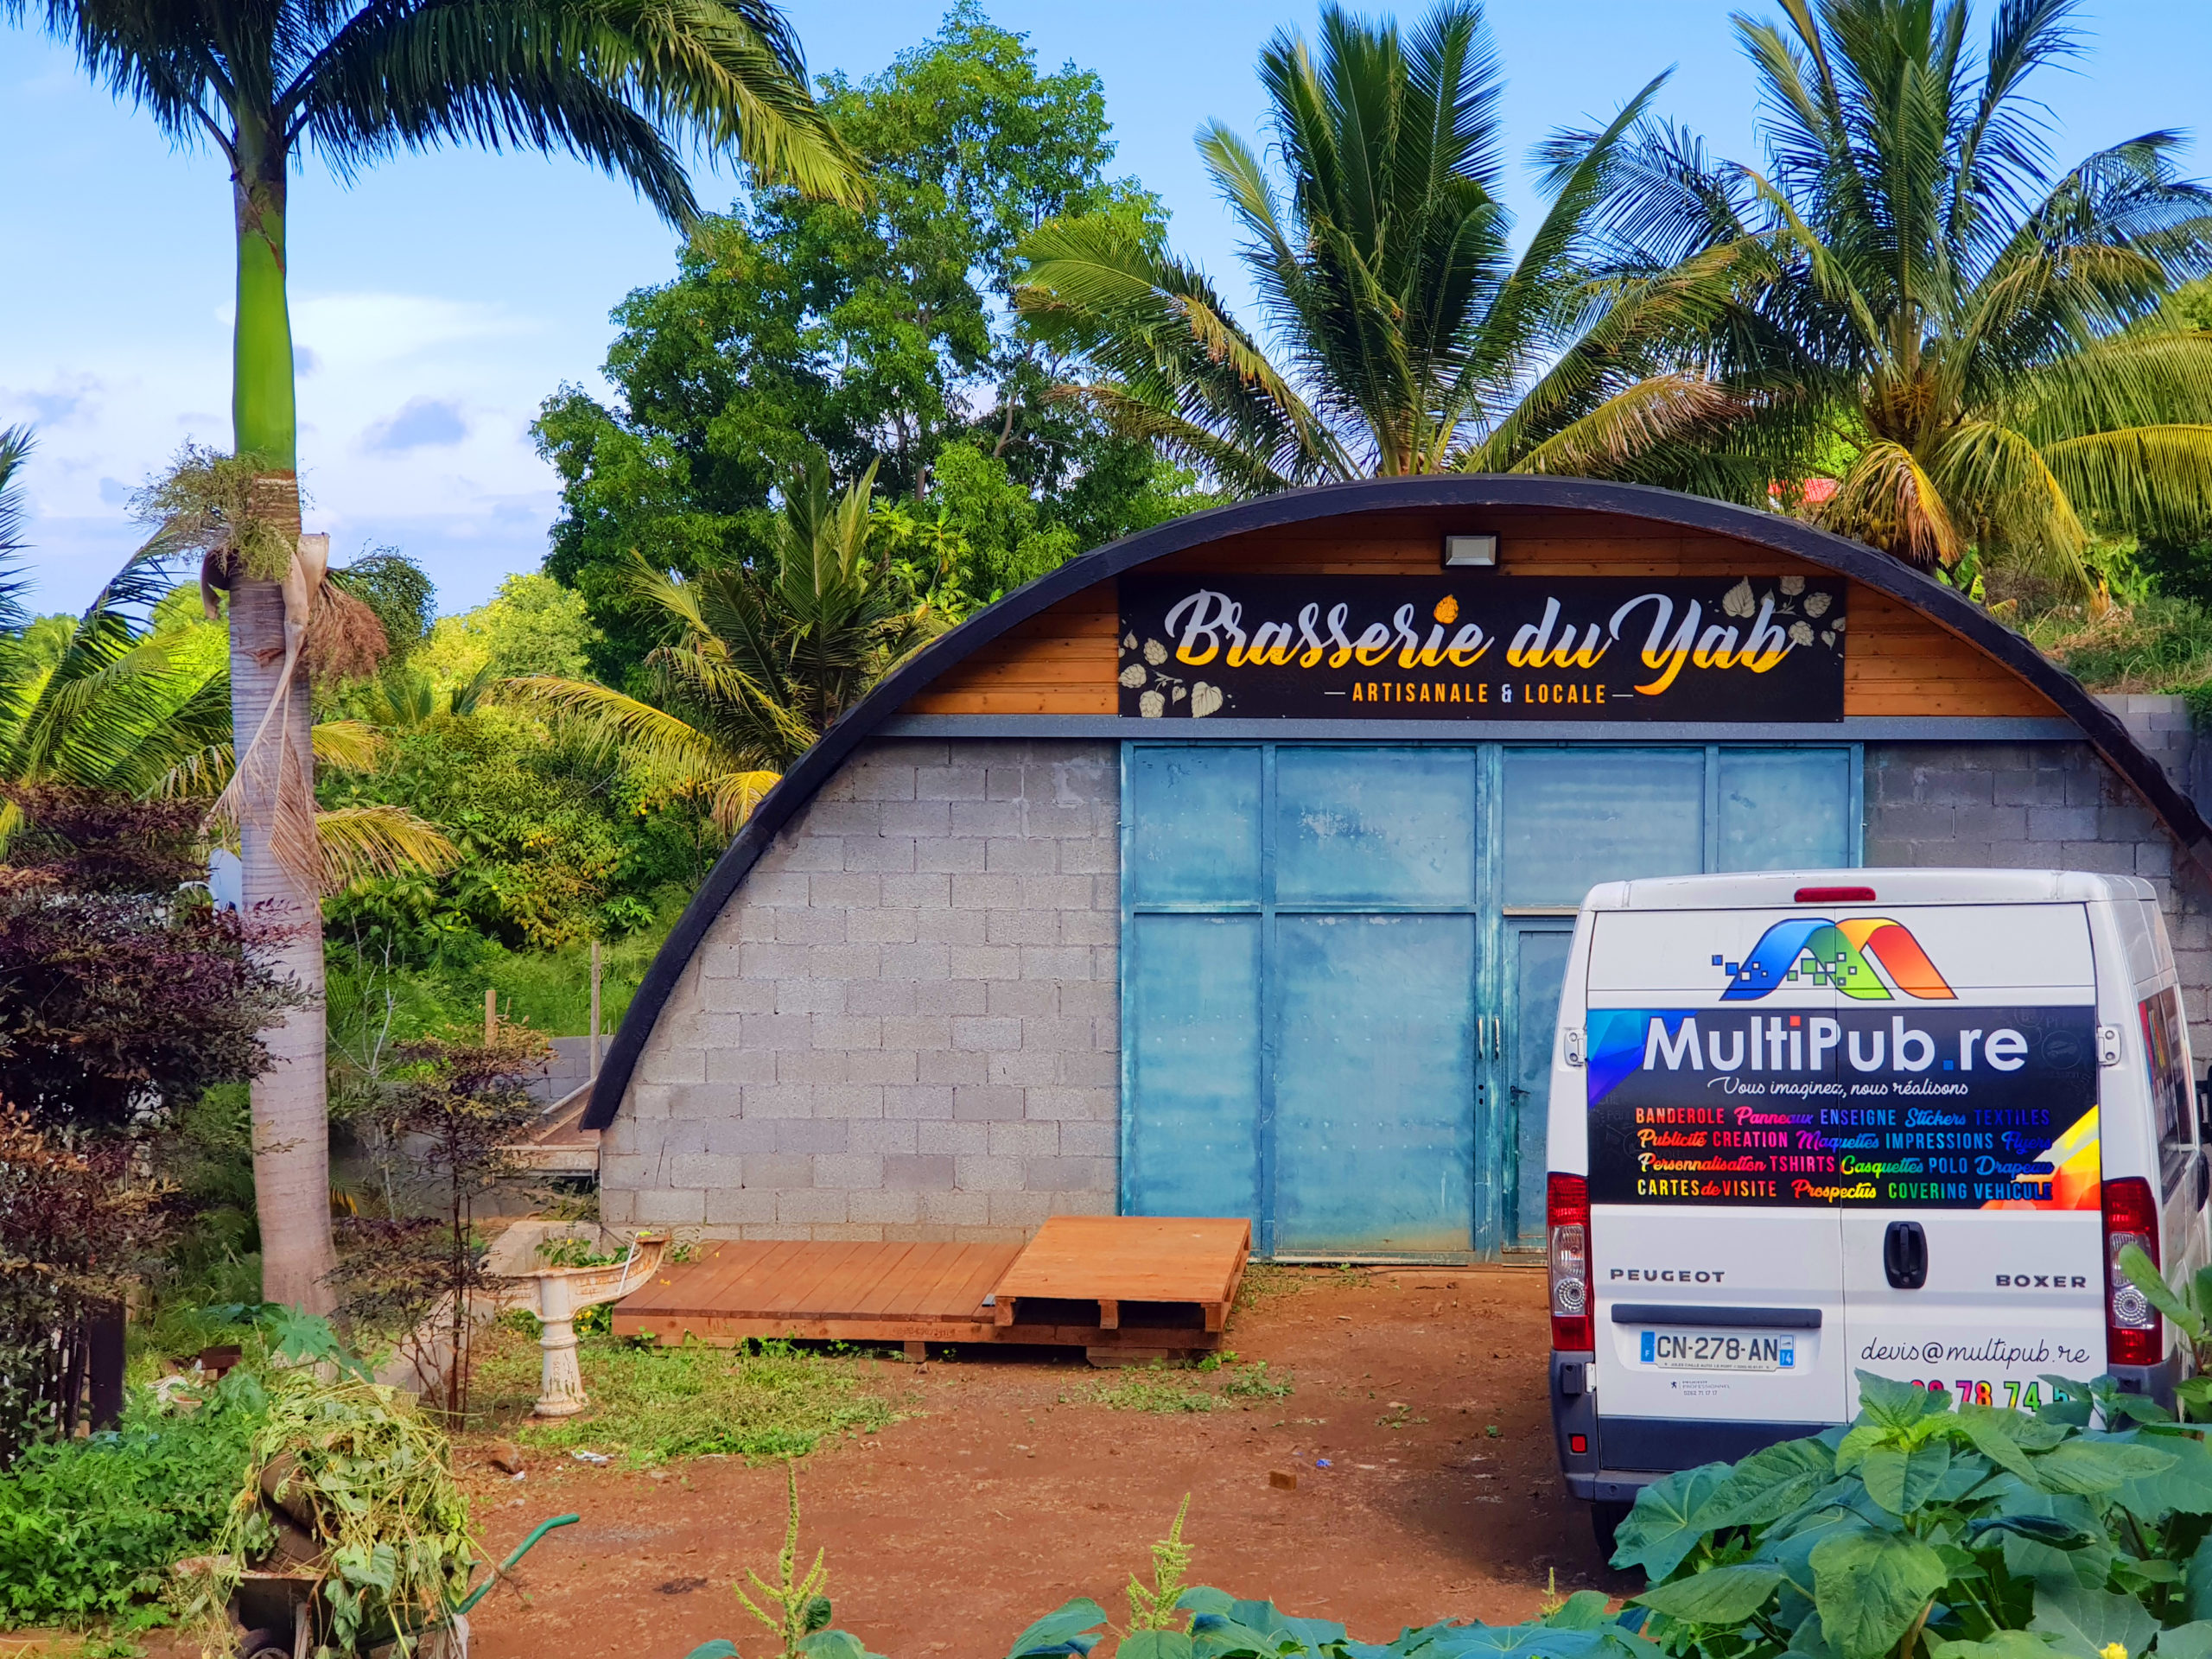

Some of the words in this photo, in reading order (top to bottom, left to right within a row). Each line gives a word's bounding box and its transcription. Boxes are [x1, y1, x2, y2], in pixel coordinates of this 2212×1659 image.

[1164, 588, 1495, 670] Brasserie
[1506, 596, 1612, 669] du
[1609, 594, 1799, 696] Yab
[1352, 682, 1488, 703] ARTISANALE
[1501, 683, 1512, 703] &
[1524, 683, 1605, 704] LOCALE
[1643, 1015, 2028, 1071] MultiPub.re
[1707, 1077, 1764, 1095] Vous
[1770, 1080, 1847, 1099] imaginez,
[1850, 1082, 1889, 1095] nous
[1893, 1078, 1968, 1096] réalisons
[1636, 1107, 1725, 1124] BANDEROLE
[1733, 1106, 1814, 1126] Panneaux
[1821, 1109, 1896, 1126] ENSEIGNE
[1904, 1108, 1967, 1128] Stickers
[1974, 1109, 2050, 1126] TEXTILES
[1713, 1131, 1788, 1147] CREATION
[1796, 1130, 1879, 1154] Maquettes
[1886, 1133, 1993, 1149] IMPRESSIONS
[2001, 1131, 2051, 1154] Flyers
[1637, 1153, 1766, 1173] Personnalisation
[1770, 1156, 1834, 1173] TSHIRTS
[1840, 1154, 1923, 1179] Casquettes
[1929, 1158, 1967, 1174] POLO
[1974, 1158, 2053, 1179] Drapeau
[1637, 1179, 1699, 1196] CARTES
[1701, 1181, 1722, 1197] de
[1723, 1180, 1777, 1198] VISITE
[1791, 1179, 1877, 1204] Prospectus
[1888, 1182, 1967, 1199] COVERING
[1974, 1183, 2053, 1200] VEHICULE
[1610, 1268, 1726, 1283] PEUGEOT
[1995, 1274, 2087, 1288] BOXER
[1644, 1350, 1650, 1358] F
[1656, 1336, 1778, 1362] CN-278-AN
[1861, 1337, 2090, 1370] devis@multipub.re
[2004, 1381, 2041, 1412] 74
